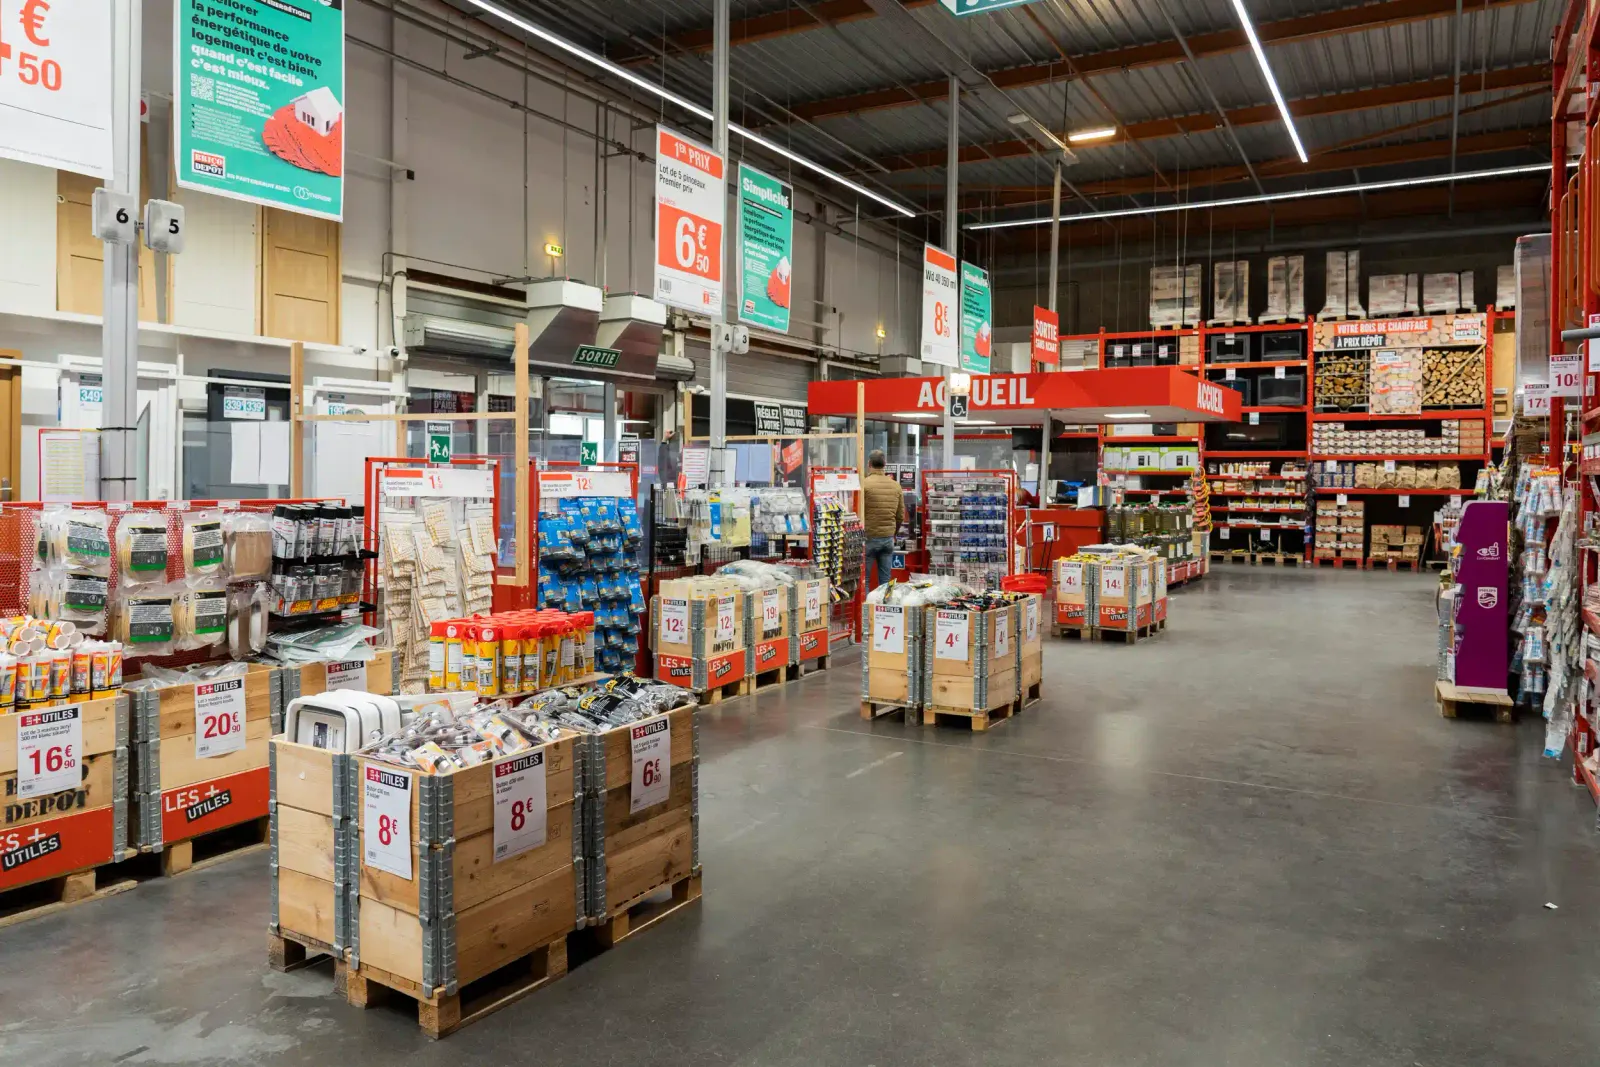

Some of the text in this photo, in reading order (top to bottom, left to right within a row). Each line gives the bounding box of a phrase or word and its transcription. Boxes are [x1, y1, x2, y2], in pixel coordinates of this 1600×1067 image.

[207, 6, 289, 42] performance
[191, 14, 322, 67] énergétique de votre
[191, 27, 255, 57] logement
[288, 61, 318, 80] bien,
[18, 52, 62, 92] 50
[191, 44, 235, 65] quand
[269, 67, 303, 87] facile
[227, 69, 271, 90] mieux.
[194, 154, 223, 166] BRICO
[688, 148, 711, 172] PRIX
[659, 164, 670, 175] Lot
[671, 168, 679, 179] de
[683, 173, 706, 190] pinceaux
[659, 174, 694, 194] Premier prix
[742, 177, 790, 209] Simplicité
[116, 208, 129, 224] 6
[168, 218, 180, 234] 5
[675, 216, 696, 268] 6
[696, 253, 710, 273] 50
[1035, 319, 1058, 341] SORTIE
[1337, 319, 1428, 334] VOTRE BOIS DE CHAUFFAGE
[724, 332, 730, 342] 4
[741, 333, 748, 344] 3
[1343, 336, 1360, 347] PRIX
[1361, 334, 1383, 346] DÉPÔT
[578, 349, 616, 365] SORTIE
[1555, 373, 1573, 387] 10
[917, 379, 1034, 408] ACUEIL
[1197, 382, 1224, 414] ACCUEIL
[1528, 398, 1542, 409] 17
[757, 406, 780, 420] RÉGLEZ
[782, 408, 804, 418] FACILITEZ
[763, 420, 780, 430] VOTRE
[783, 417, 796, 427] TOUS
[576, 478, 588, 490] 12
[1066, 576, 1072, 586] 4
[1105, 579, 1117, 590] 14
[766, 606, 775, 620] 19
[1101, 607, 1116, 615] LES
[665, 617, 679, 632] 12
[720, 615, 730, 630] 12
[755, 645, 767, 656] LES
[341, 661, 362, 670] UTILES
[660, 657, 678, 669] LES
[708, 659, 721, 673] LES
[671, 667, 692, 677] UTILES
[213, 681, 239, 692] UTILES
[42, 709, 74, 723] UTILES
[30, 729, 37, 737] de
[203, 712, 231, 739] 20
[231, 724, 241, 733] 90
[645, 721, 665, 735] UTILES
[28, 744, 73, 775] 16 €
[63, 758, 76, 769] 90
[512, 754, 540, 771] UTILES
[380, 773, 405, 788] UTILES
[643, 760, 654, 787] 6
[653, 774, 661, 785] 90
[165, 790, 199, 813] LES
[187, 791, 232, 821] UTILES
[4, 837, 60, 869] UTILES
